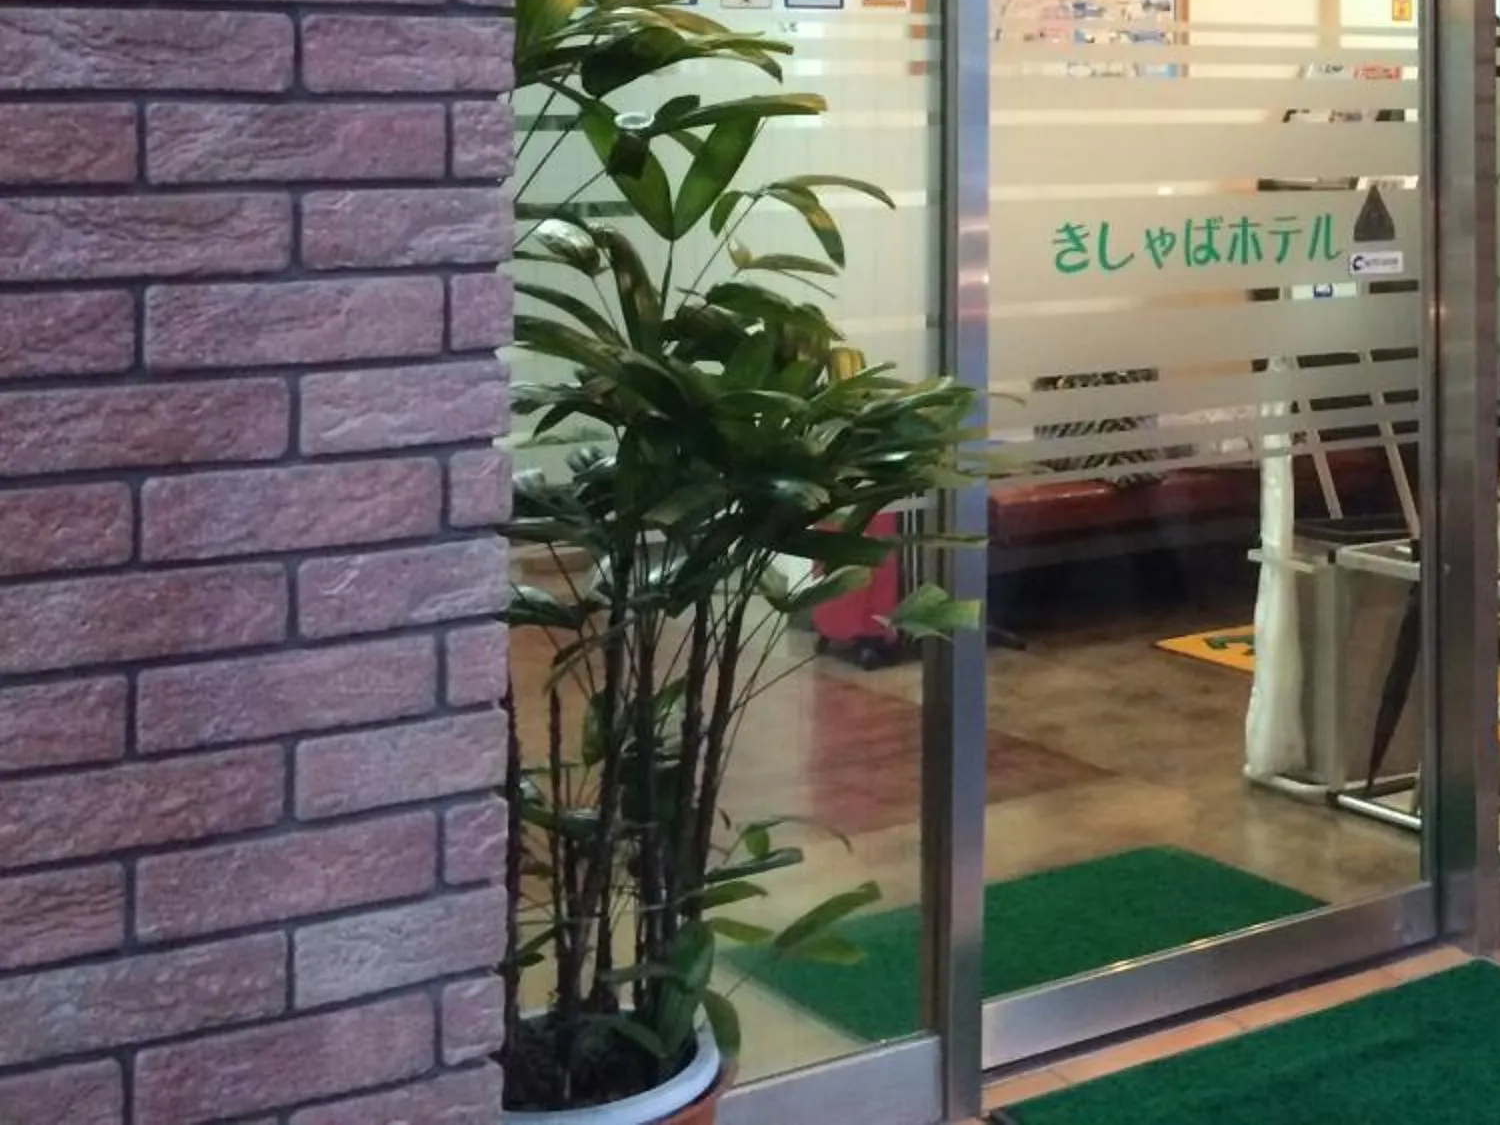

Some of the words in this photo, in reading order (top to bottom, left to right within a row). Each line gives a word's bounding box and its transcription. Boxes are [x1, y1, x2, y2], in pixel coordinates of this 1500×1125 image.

[1053, 213, 1343, 274] きしゃばホテル
